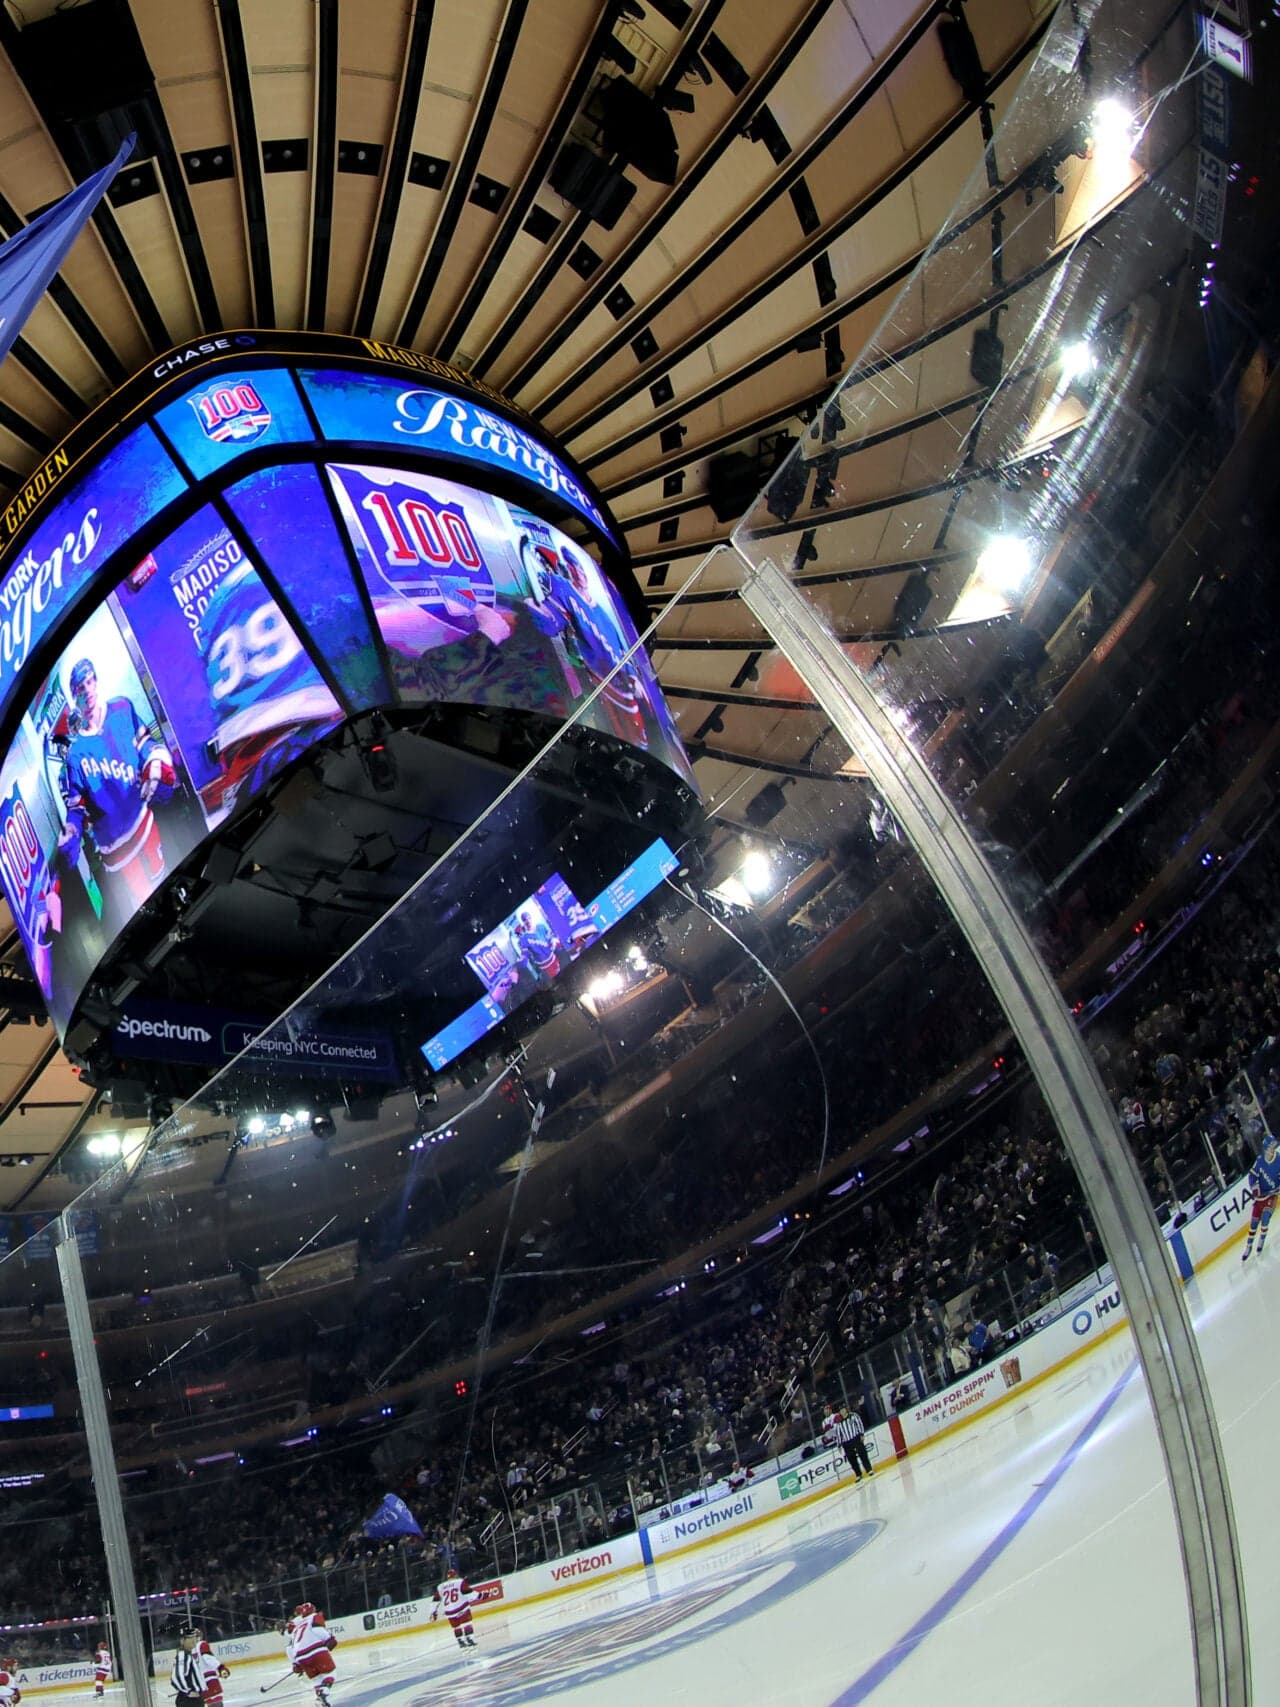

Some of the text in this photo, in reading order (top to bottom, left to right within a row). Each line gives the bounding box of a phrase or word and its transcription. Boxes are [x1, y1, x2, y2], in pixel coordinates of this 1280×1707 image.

[154, 338, 232, 379] CHASE
[199, 384, 262, 428] 100
[5, 447, 70, 535] GARDEN
[362, 491, 481, 573] 100
[209, 600, 303, 700] 39
[0, 800, 37, 914] 100
[117, 1015, 206, 1043] Spectrum
[243, 1033, 377, 1060] Keeping NYC Connected
[923, 1400, 942, 1418] MIN
[943, 1390, 963, 1406] FOR
[674, 1495, 754, 1539] Northwell
[550, 1551, 613, 1582] verizon
[163, 1594, 199, 1606] ULTRA
[376, 1603, 418, 1621] CAESARS
[443, 1588, 459, 1607] 26
